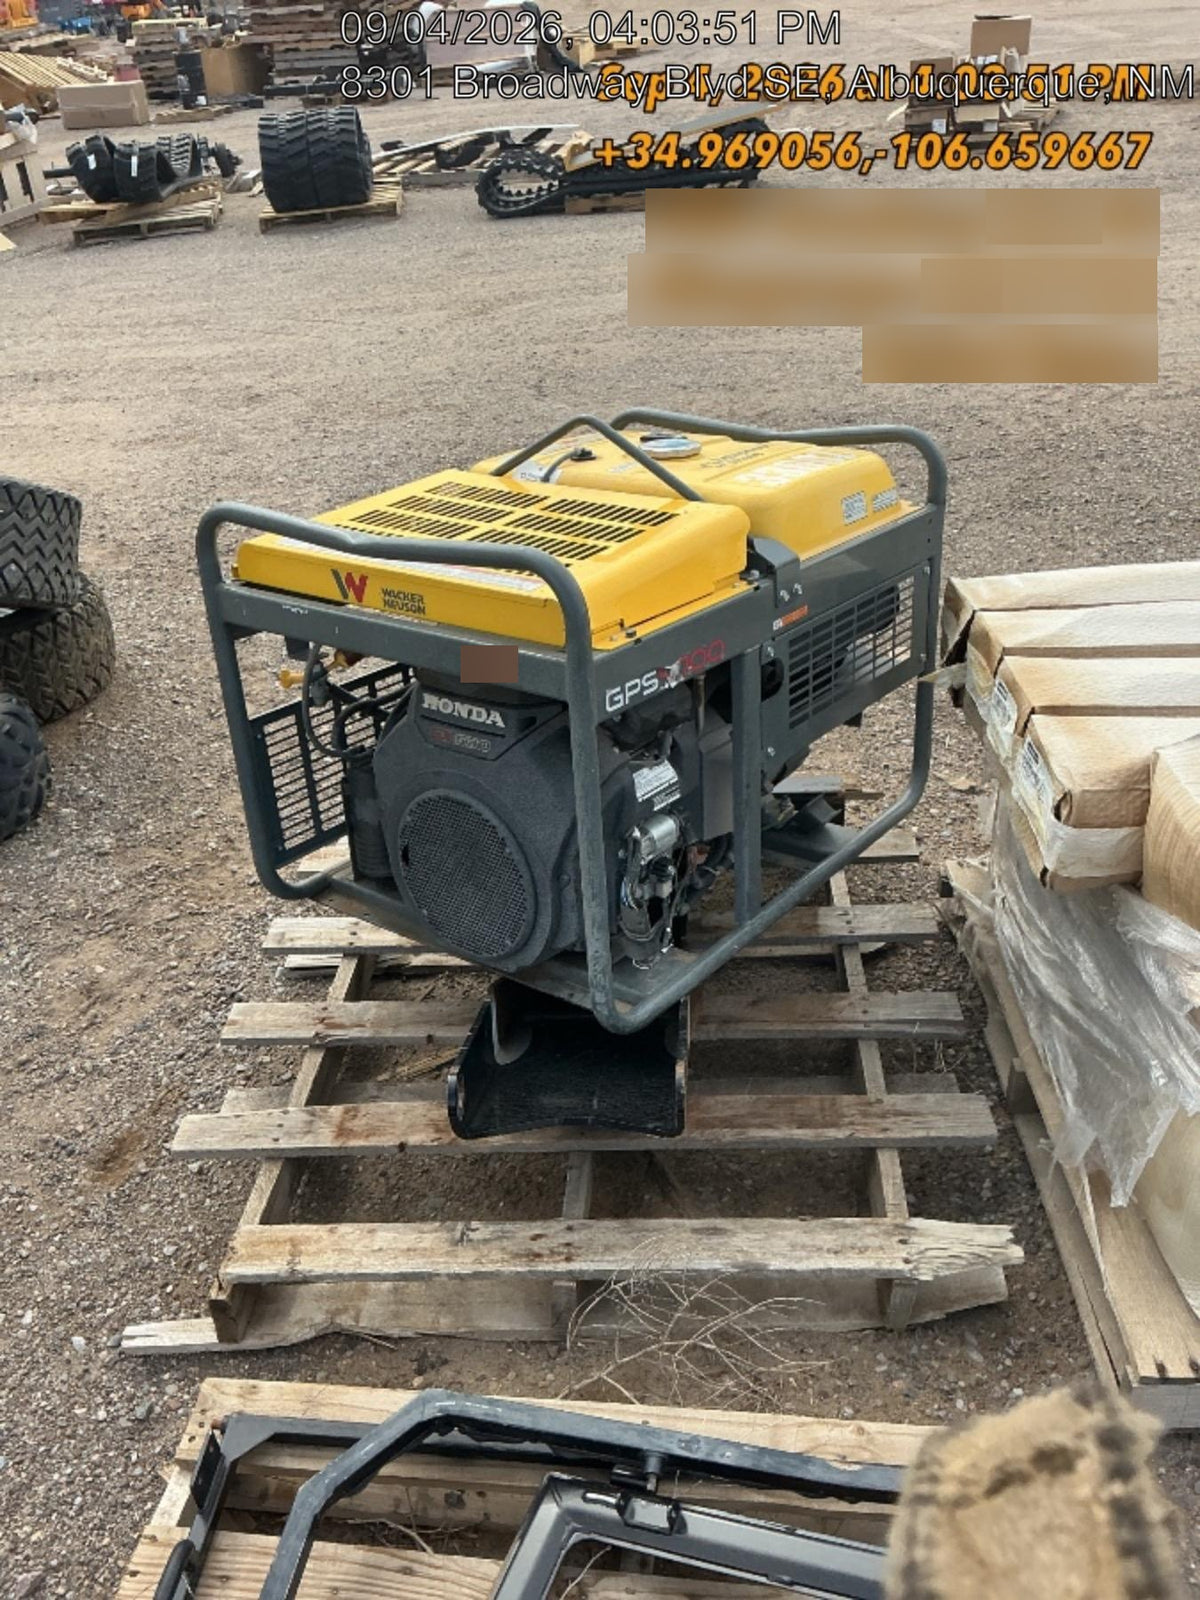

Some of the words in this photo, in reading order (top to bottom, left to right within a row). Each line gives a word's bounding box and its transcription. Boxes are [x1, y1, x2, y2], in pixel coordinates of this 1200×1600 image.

[382, 588, 424, 604] WACKER
[383, 598, 426, 615] NEUSON
[422, 693, 506, 728] HONDA
